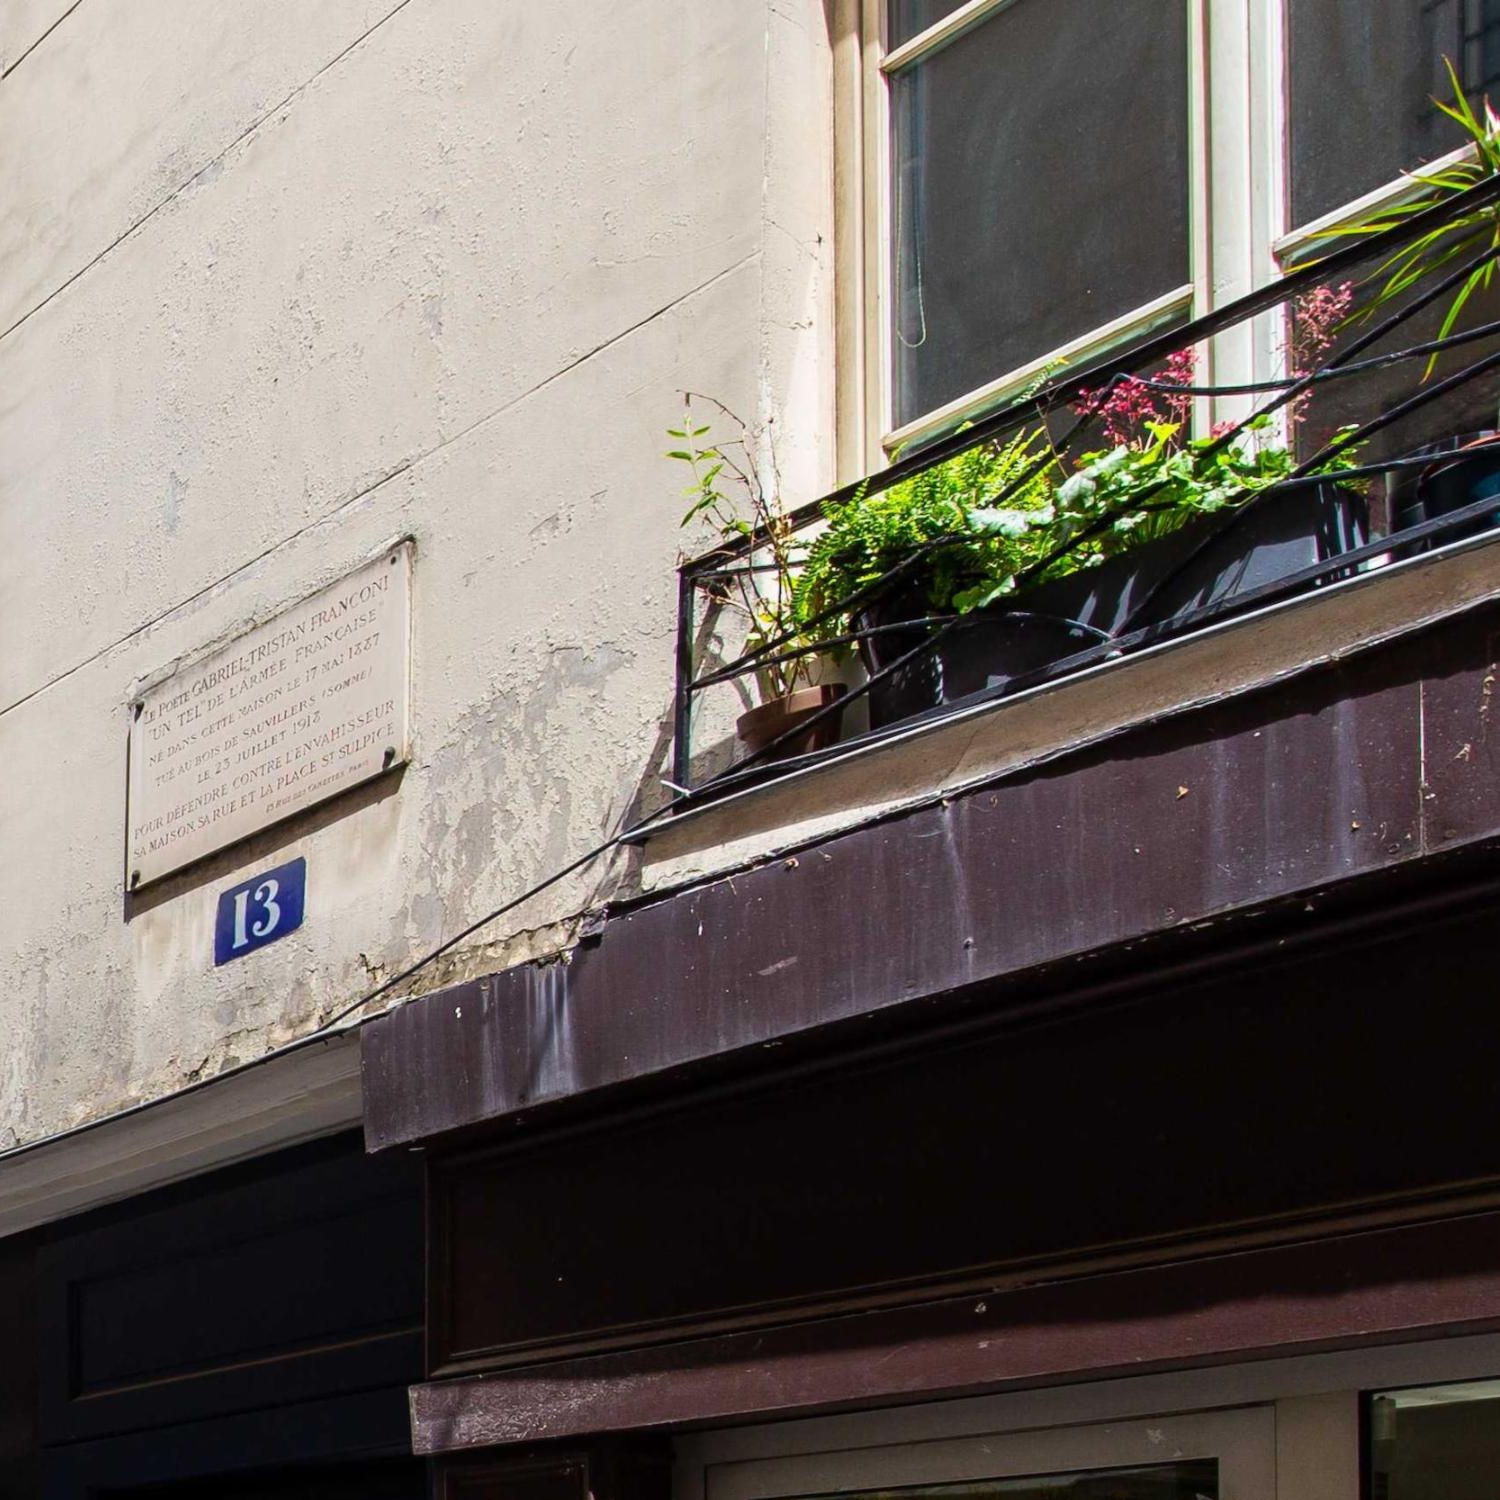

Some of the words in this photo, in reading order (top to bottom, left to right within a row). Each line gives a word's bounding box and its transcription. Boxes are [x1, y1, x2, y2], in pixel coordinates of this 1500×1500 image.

[191, 619, 305, 700] GABRIEL-TRISTAN
[310, 572, 388, 633] FRANCONI
[166, 731, 198, 758] DANS
[200, 711, 235, 740] CETTE
[237, 685, 282, 720] MAISON
[287, 675, 301, 693] LE
[305, 664, 317, 683] 17
[321, 652, 344, 675] MAI
[177, 758, 192, 776] AU
[194, 743, 220, 767] BOIS
[224, 734, 238, 751] DE
[242, 692, 316, 742] SAUVILLERS
[207, 691, 224, 712] DE
[197, 768, 210, 784] LE
[234, 728, 286, 765] JUILLET
[292, 708, 321, 735] 1918
[133, 843, 146, 860] SA
[197, 811, 210, 829] SA
[212, 798, 237, 822] RUE
[240, 789, 256, 808] ET
[260, 781, 273, 798] LA
[276, 759, 317, 790] PLACE
[338, 721, 394, 760] SULPICE
[134, 814, 163, 840] POUR
[232, 754, 282, 791] CONTRE
[232, 879, 281, 949] 13
